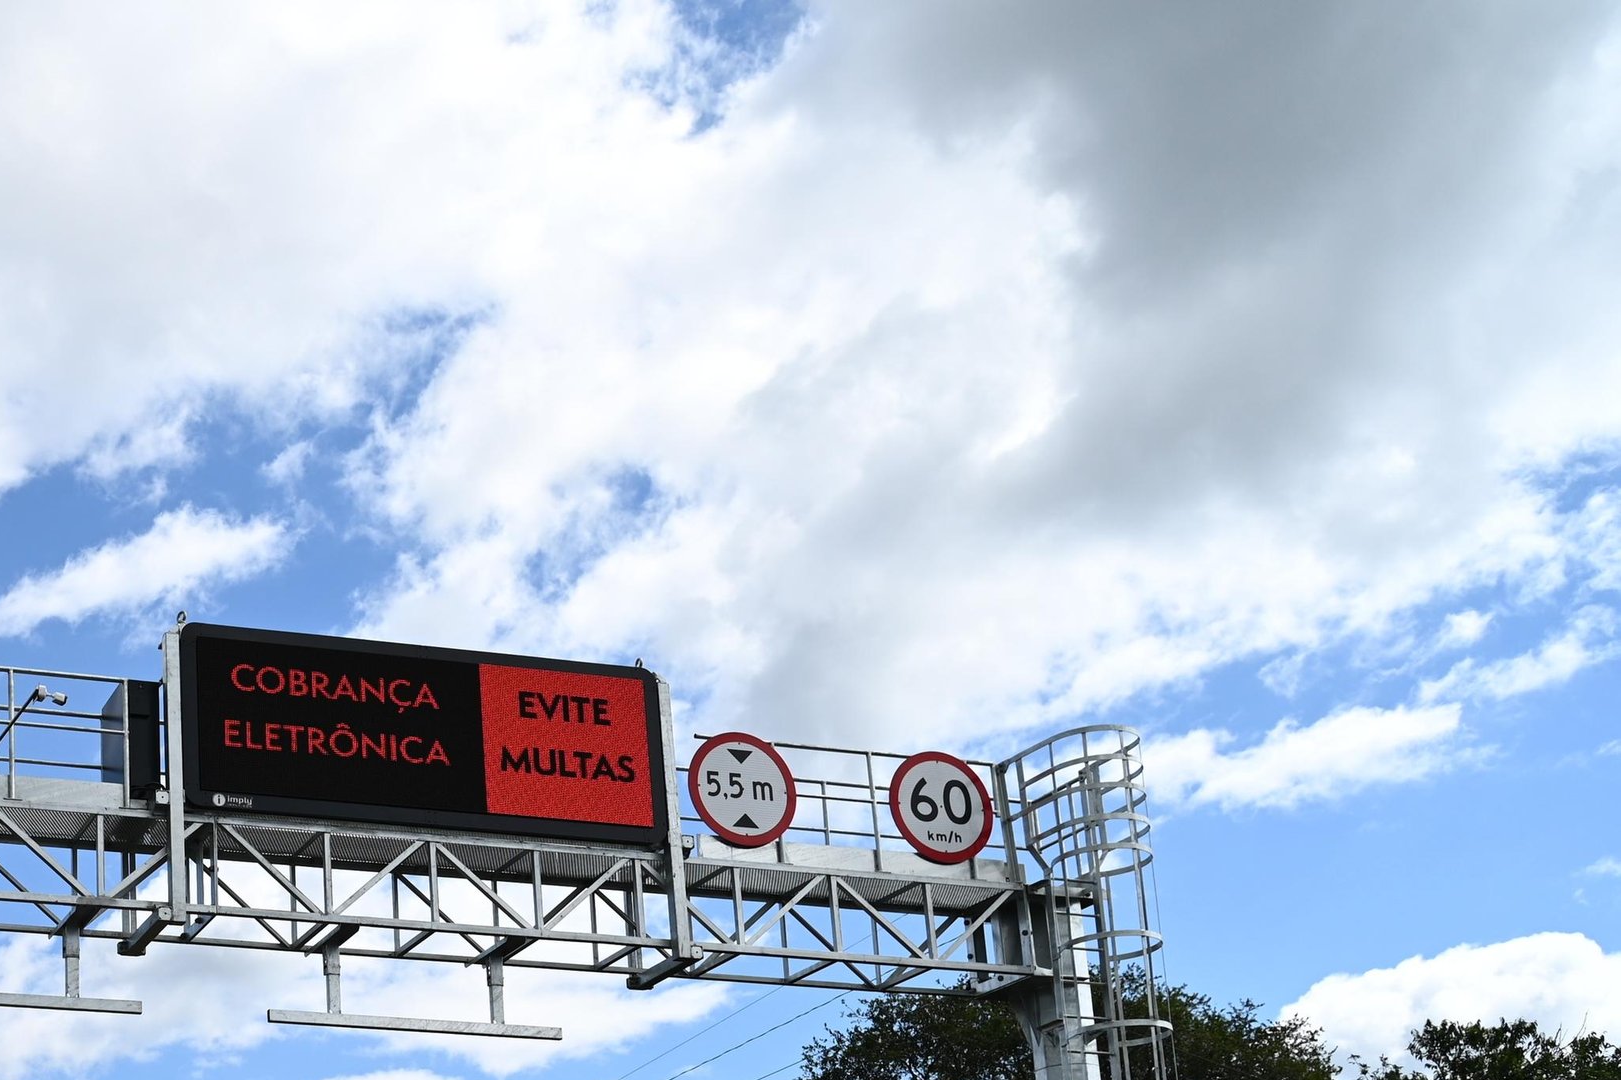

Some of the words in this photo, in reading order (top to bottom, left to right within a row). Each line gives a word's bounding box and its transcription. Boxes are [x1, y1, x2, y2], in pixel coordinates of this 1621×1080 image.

[231, 663, 440, 713] COBRANÇA
[518, 690, 612, 726] EVITE
[224, 719, 451, 766] ELETRÔNICA
[501, 745, 635, 783] MULTAS
[706, 770, 744, 800] 5,5
[752, 780, 774, 801] m
[910, 777, 972, 825] 60
[927, 831, 962, 844] km/h
